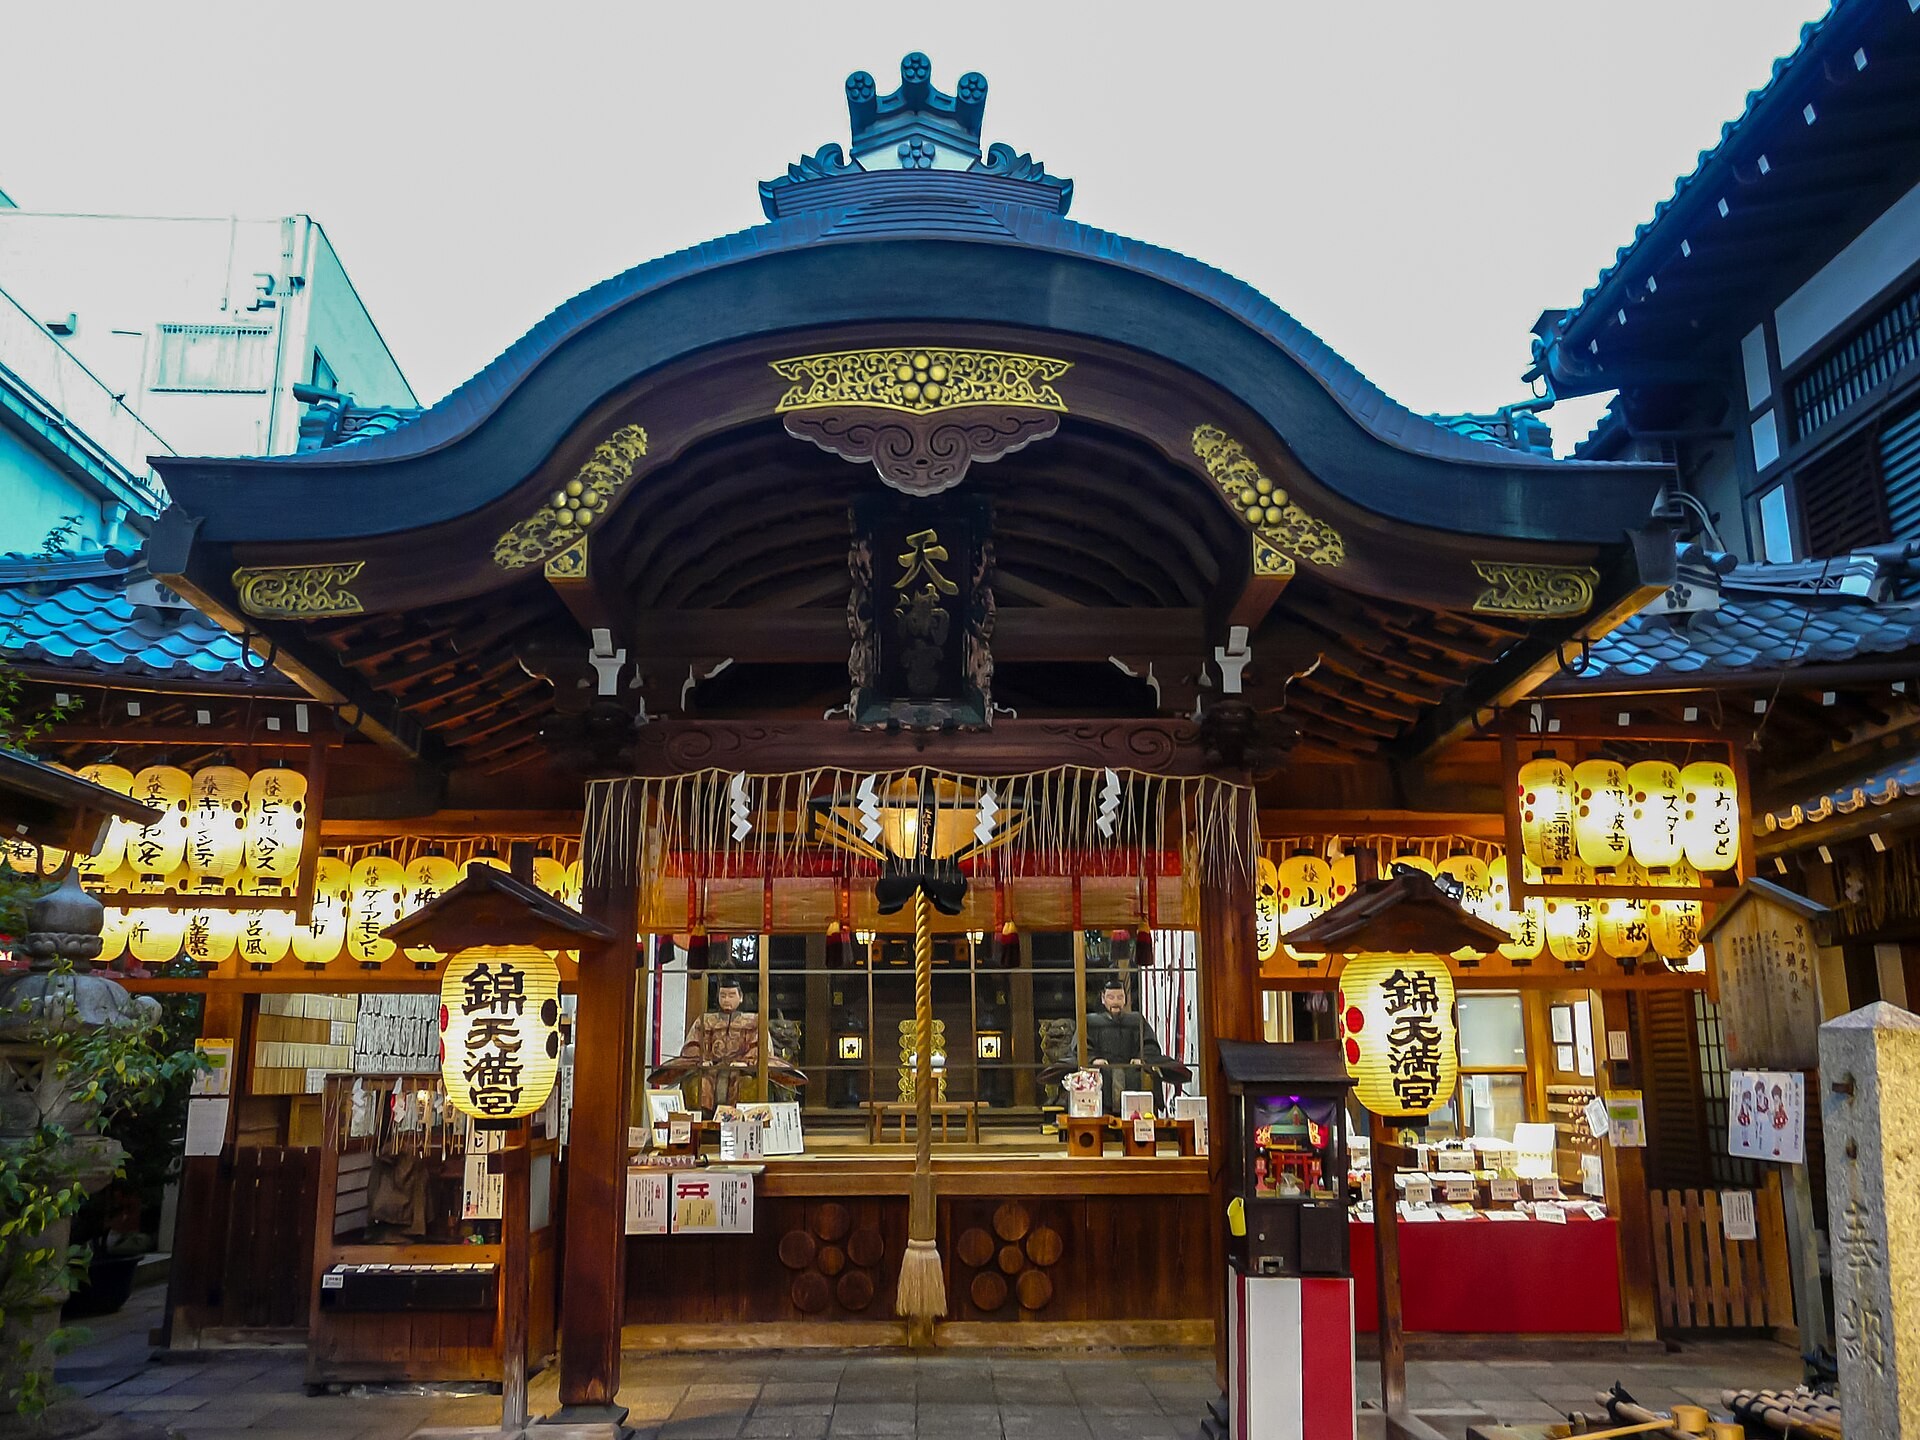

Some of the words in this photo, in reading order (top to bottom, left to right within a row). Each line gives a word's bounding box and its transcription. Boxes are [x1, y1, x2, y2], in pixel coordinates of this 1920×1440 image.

[1662, 795, 1679, 845] スター
[461, 962, 528, 1116] 錦天満宮
[1379, 960, 1443, 1110] 錦天満宮
